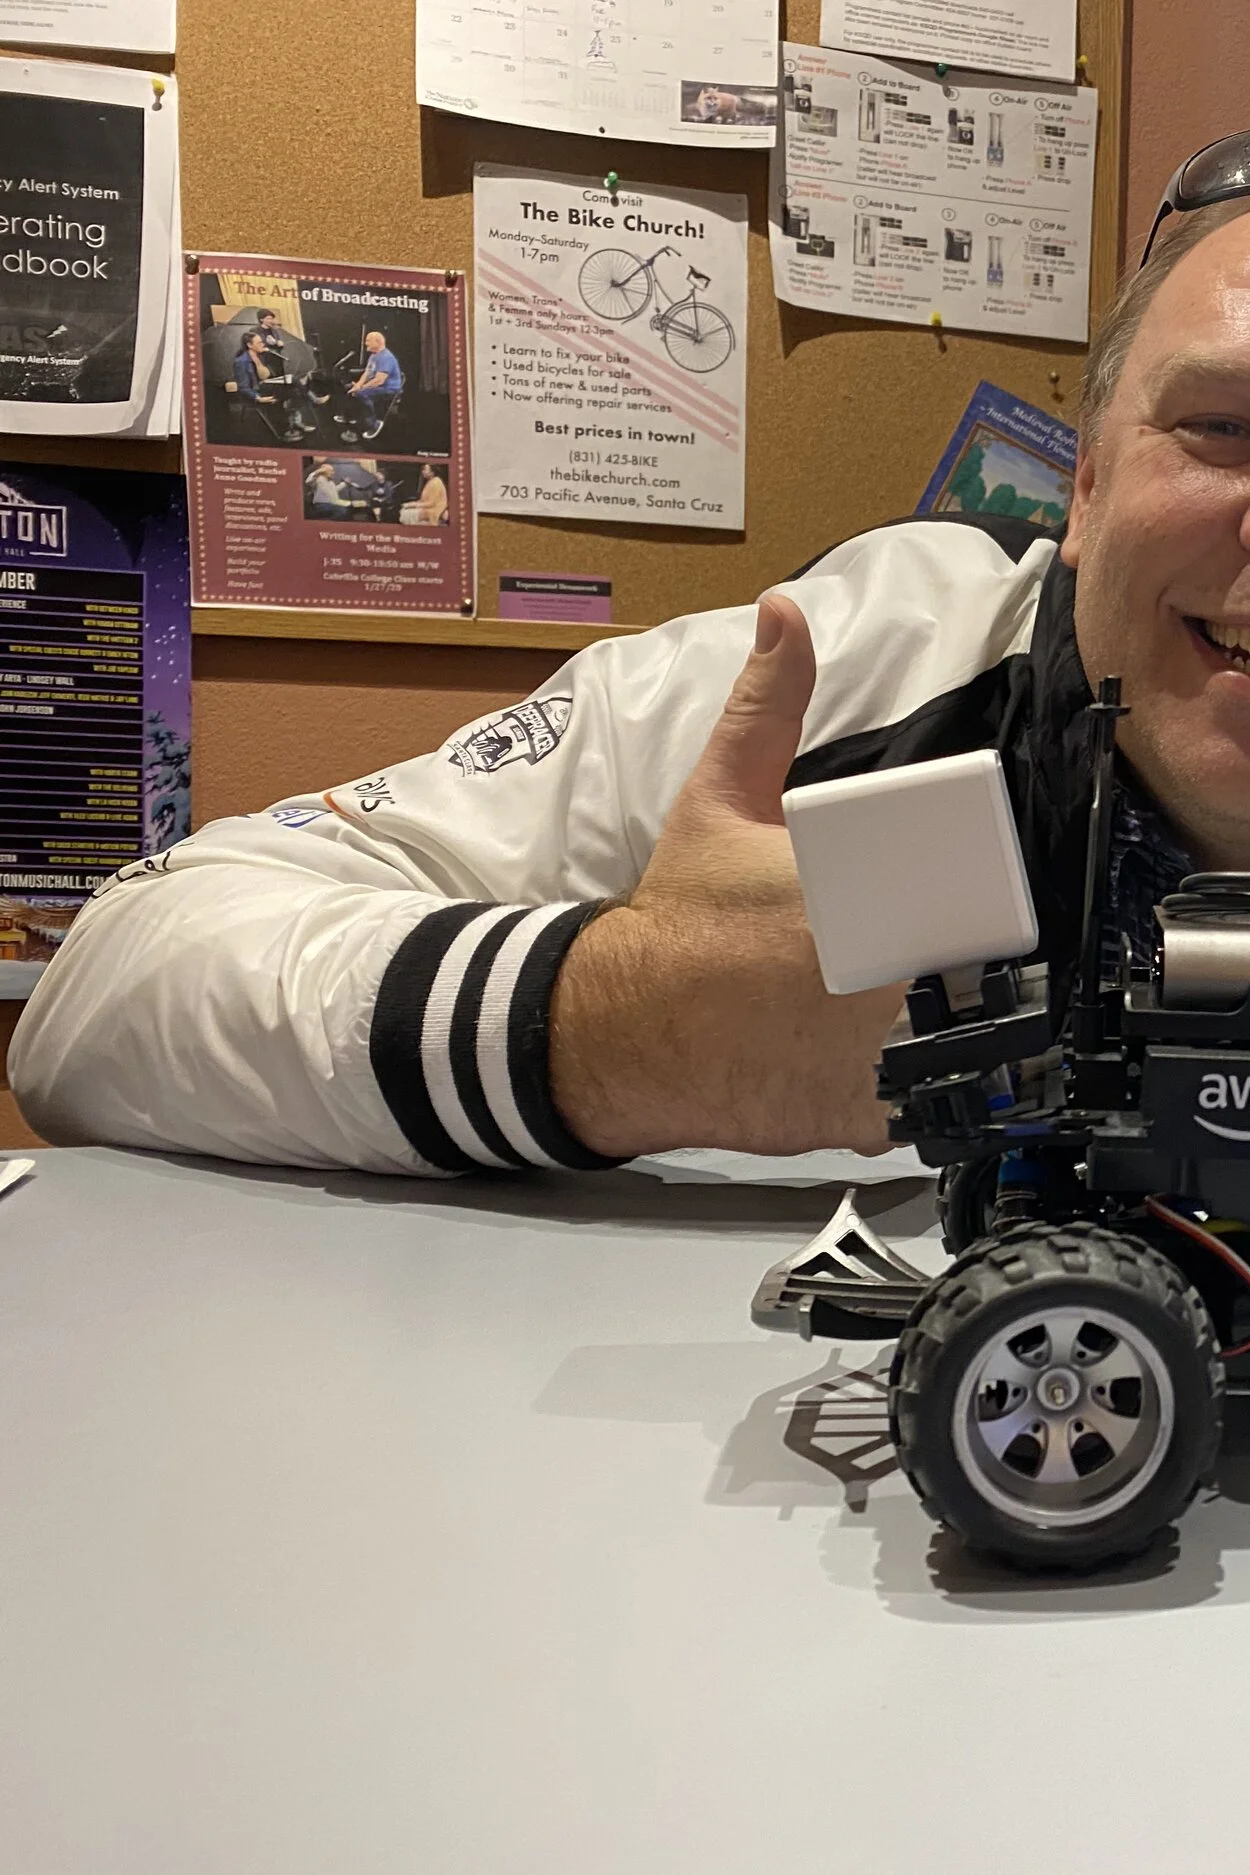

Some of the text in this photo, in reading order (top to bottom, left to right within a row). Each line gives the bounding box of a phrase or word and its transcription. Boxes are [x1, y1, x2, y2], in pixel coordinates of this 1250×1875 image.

[18, 178, 57, 194] Alert
[61, 183, 120, 200] System
[582, 190, 643, 207] Com visit
[0, 214, 105, 248] erating
[520, 202, 705, 239] The Bike Church!
[2, 249, 108, 279] dbook
[234, 280, 429, 313] The Art of Broadcasting
[488, 290, 529, 305] Women,
[488, 303, 496, 312] &
[499, 304, 535, 317] Femme
[536, 308, 558, 321] only
[489, 315, 503, 326] 1st
[514, 317, 533, 329] 3rd
[535, 319, 577, 335] Sundays
[27, 355, 48, 364] Alert
[503, 343, 630, 366] Learn to fix your bike
[503, 359, 632, 380] Used bicycles for sale
[503, 374, 652, 398] Tons of new & used parts
[503, 390, 672, 413] Now offering repair services
[535, 420, 696, 445] Best prices in town!
[255, 459, 278, 467] radio
[569, 450, 659, 468] (831) 425-BIKE
[550, 467, 680, 489] thebikechurch.com
[500, 485, 724, 513] 703 Pacific Avenue, Santa Cruz
[319, 532, 442, 545] Writing for the Broadcast
[366, 544, 397, 554] Media
[511, 702, 556, 760] DEEPRACER
[353, 776, 396, 812] aws
